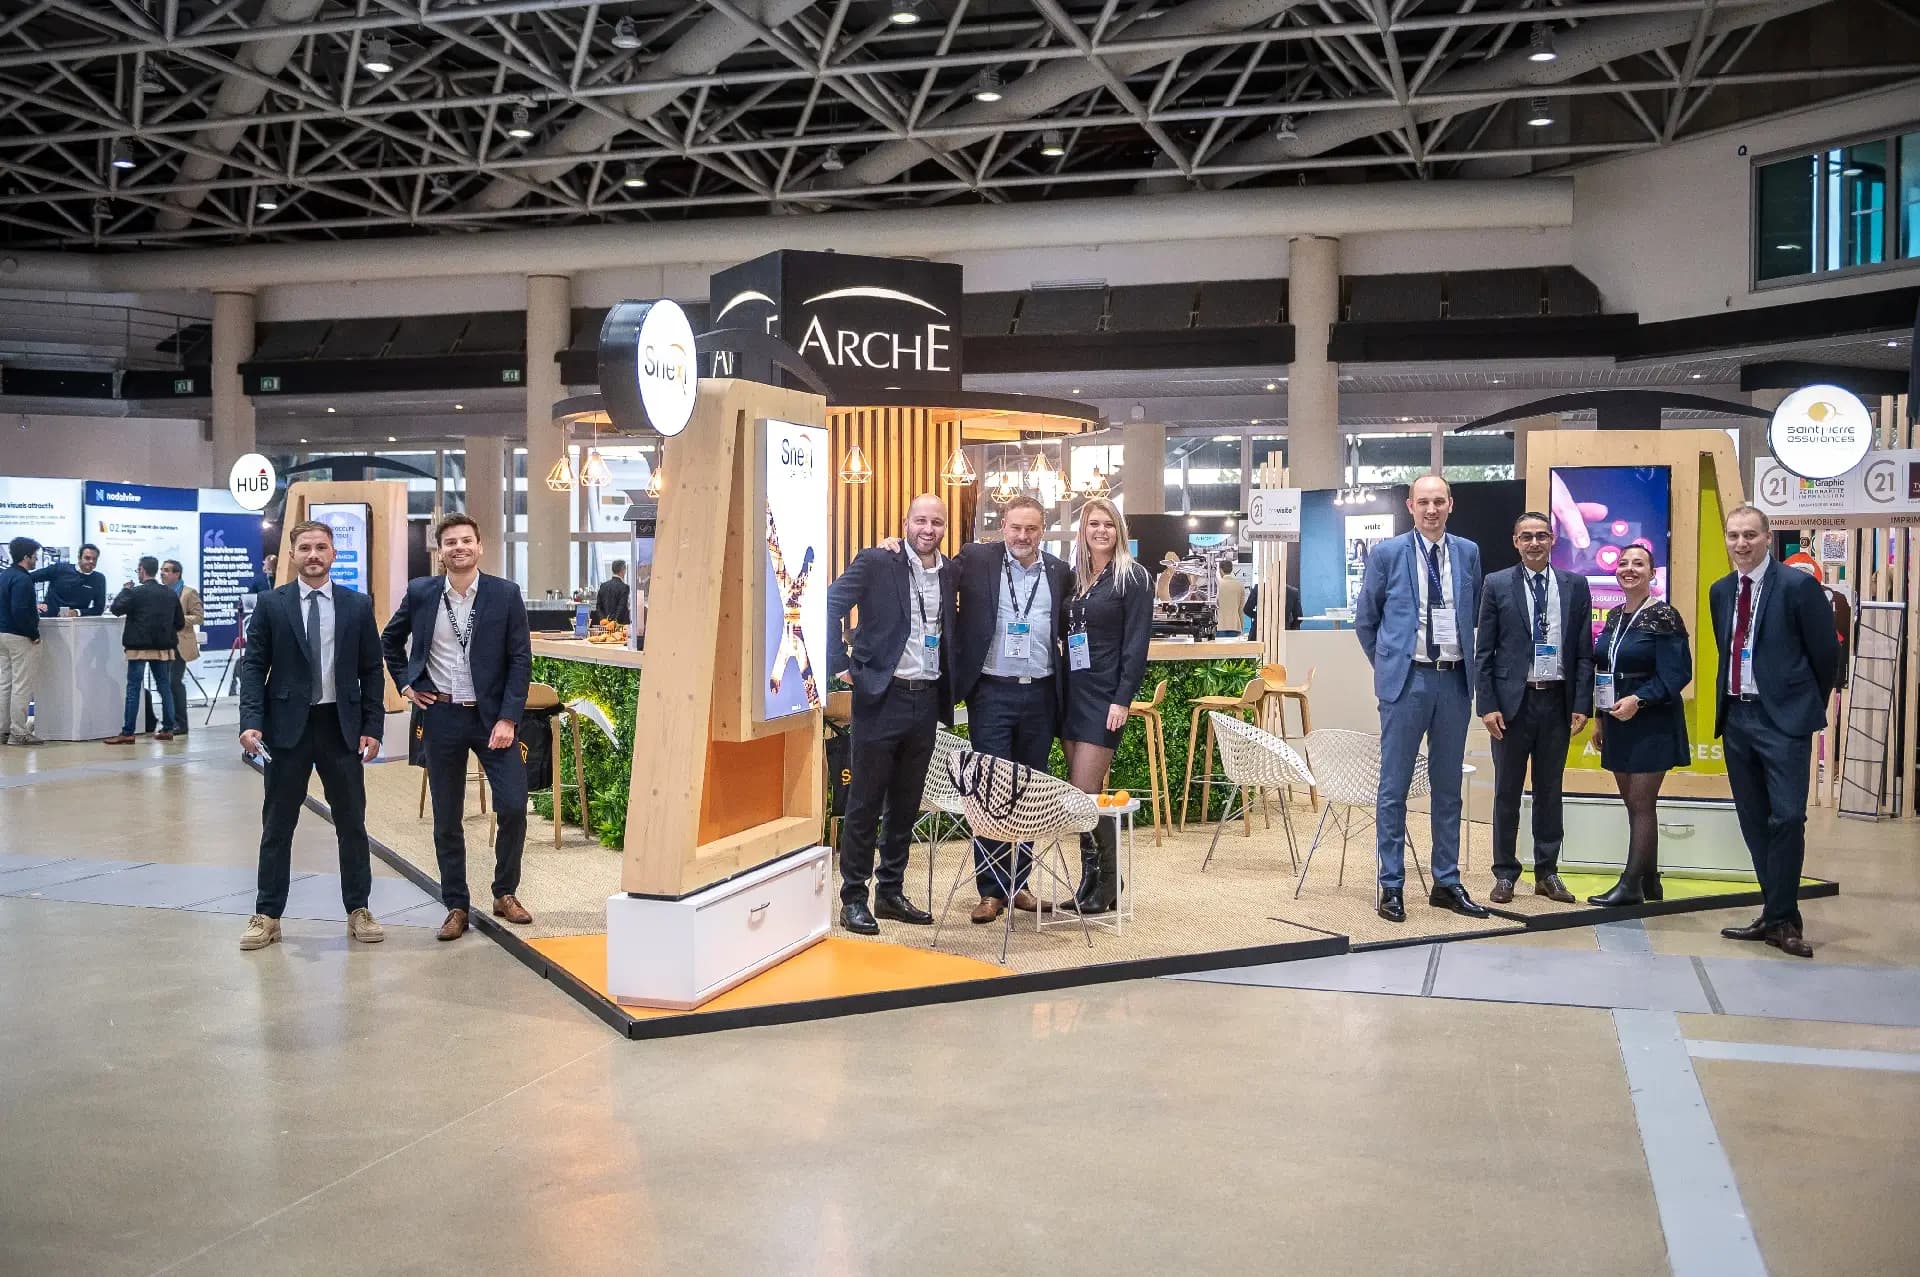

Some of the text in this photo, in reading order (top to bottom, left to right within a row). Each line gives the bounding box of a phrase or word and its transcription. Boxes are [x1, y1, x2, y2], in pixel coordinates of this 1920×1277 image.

[798, 314, 950, 372] ARCHE
[781, 437, 813, 470] Snei
[237, 476, 269, 492] HUB
[1815, 478, 1845, 488] Graphic
